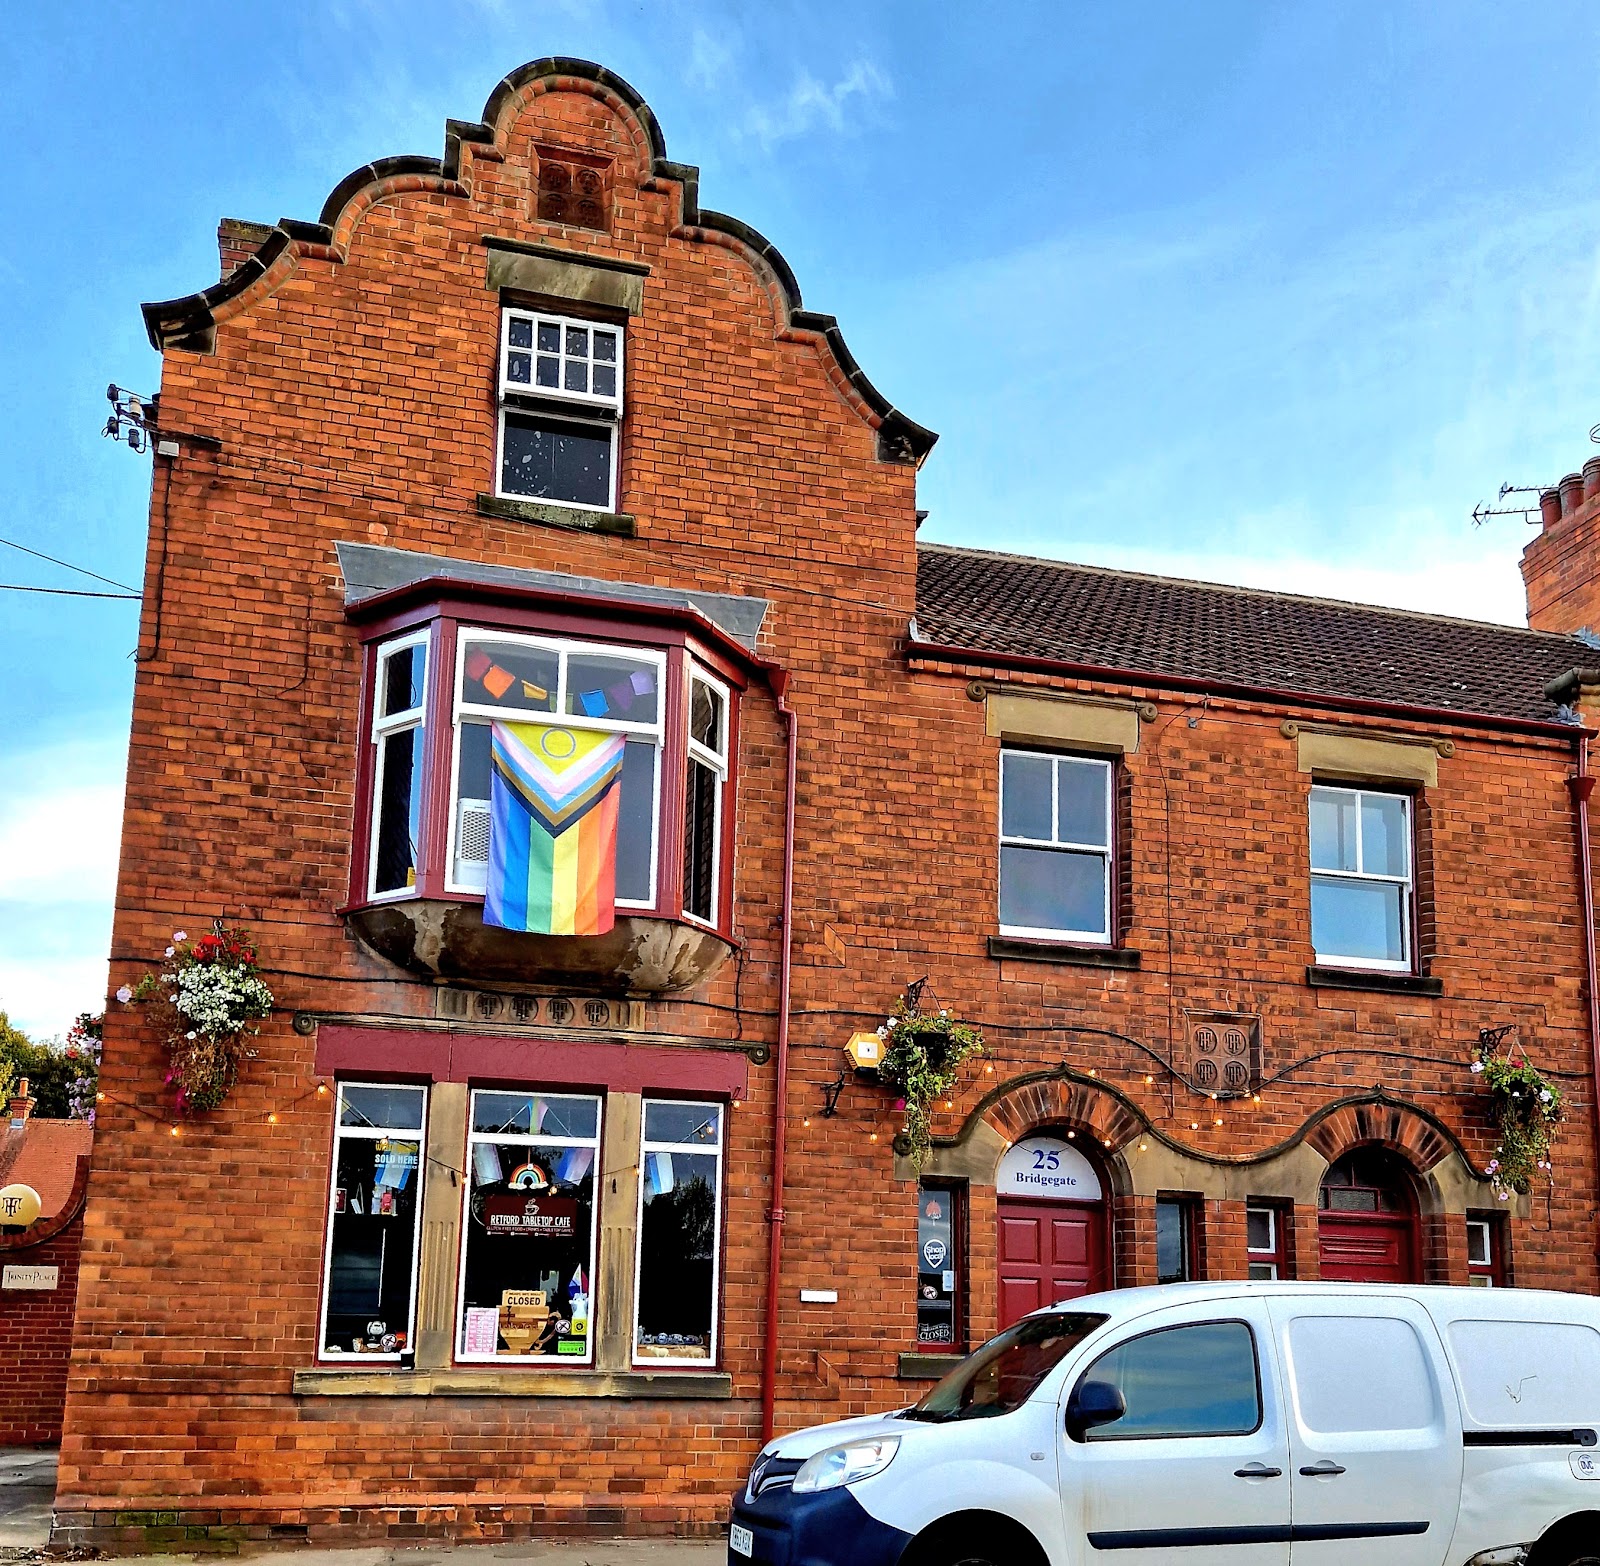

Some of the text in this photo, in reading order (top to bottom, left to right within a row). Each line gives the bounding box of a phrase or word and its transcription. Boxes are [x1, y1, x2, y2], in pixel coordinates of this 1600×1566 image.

[374, 1154, 418, 1165] SOLD HERE
[1033, 1149, 1060, 1170] 25
[1016, 1172, 1077, 1187] Bridgegate
[490, 1215, 571, 1227] RETFORD TABLETOP CAFE
[926, 1246, 944, 1254] Shop
[928, 1252, 944, 1260] local
[507, 1296, 541, 1306] CLOSED
[919, 1328, 950, 1341] CLOSED
